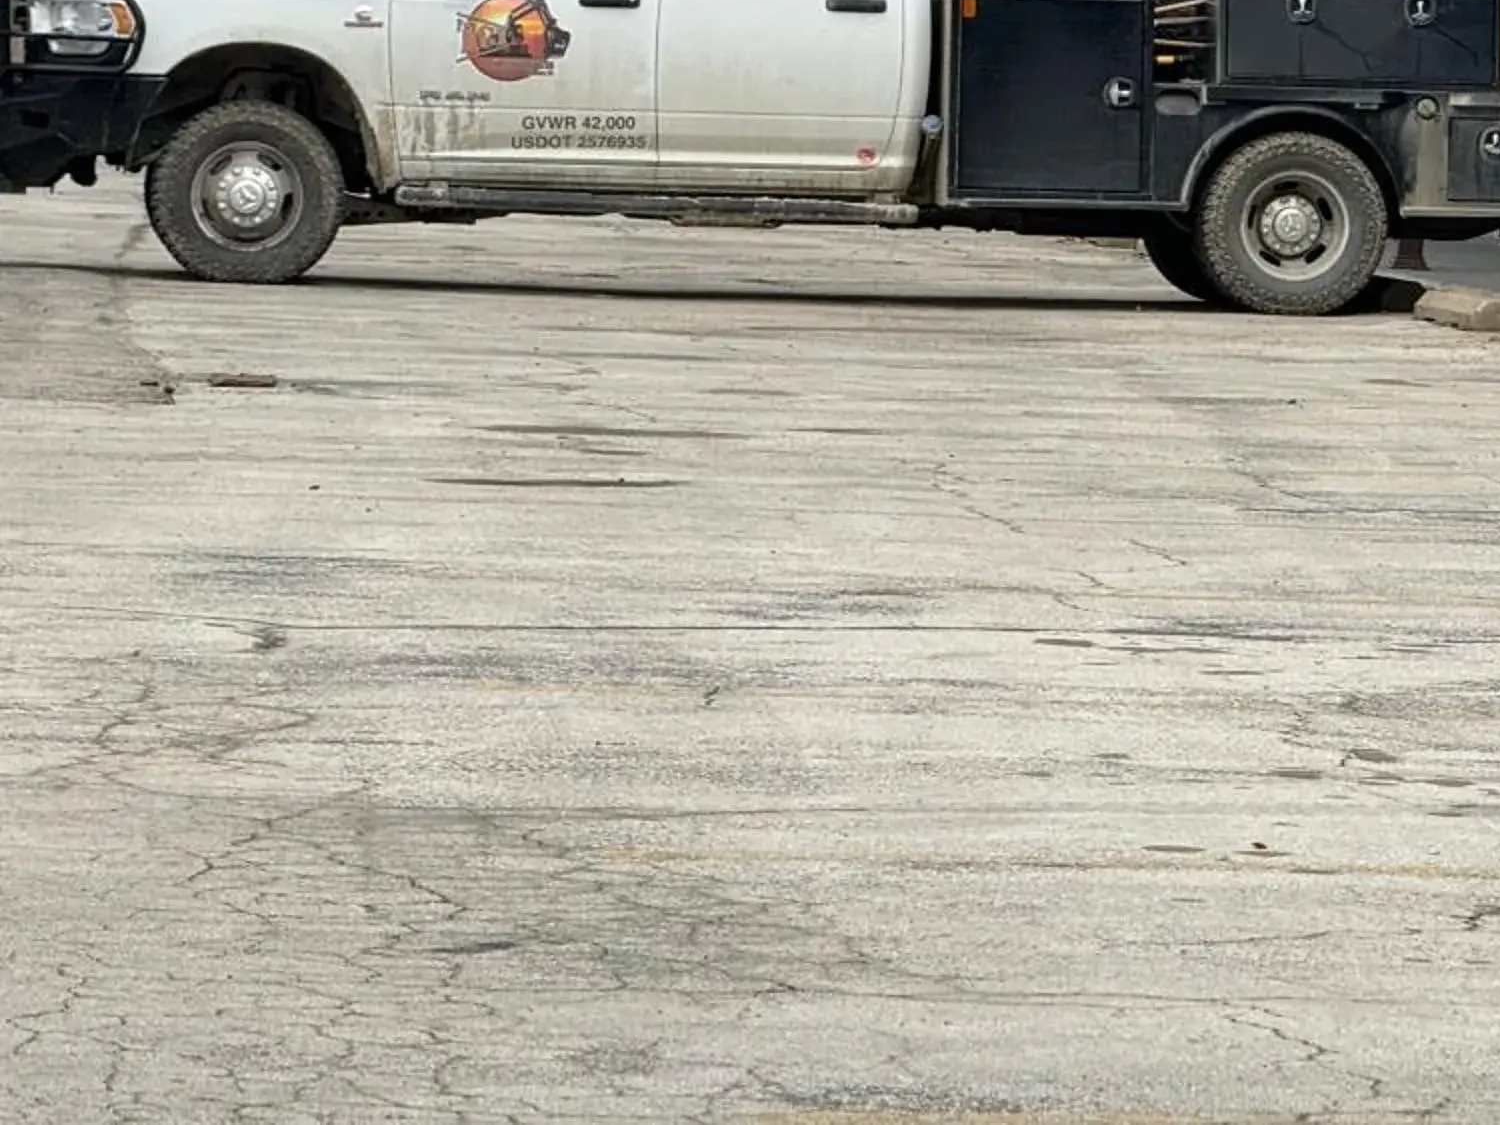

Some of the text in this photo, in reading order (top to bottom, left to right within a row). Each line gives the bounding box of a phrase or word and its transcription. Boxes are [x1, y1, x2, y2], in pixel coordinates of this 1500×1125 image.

[521, 115, 636, 131] GVWR 42,000
[511, 135, 573, 150] USDOT
